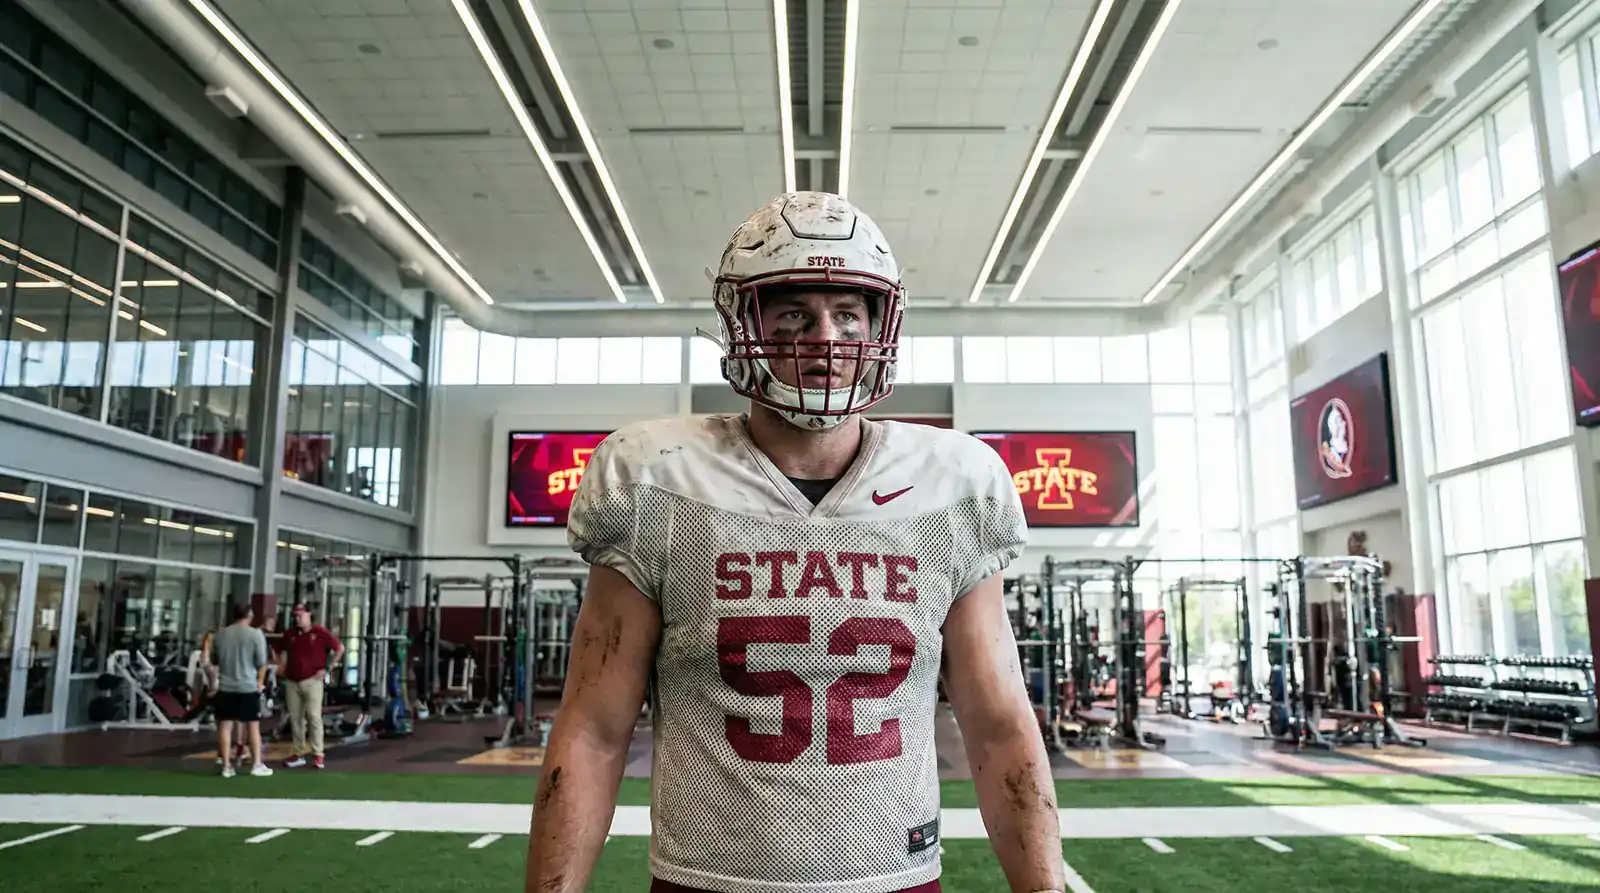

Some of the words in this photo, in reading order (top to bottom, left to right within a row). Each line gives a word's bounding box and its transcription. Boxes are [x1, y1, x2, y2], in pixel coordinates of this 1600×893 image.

[807, 256, 846, 267] STATE
[547, 467, 584, 495] ST
[1013, 467, 1098, 496] STATE
[715, 551, 918, 603] STATE
[716, 615, 916, 766] 52
